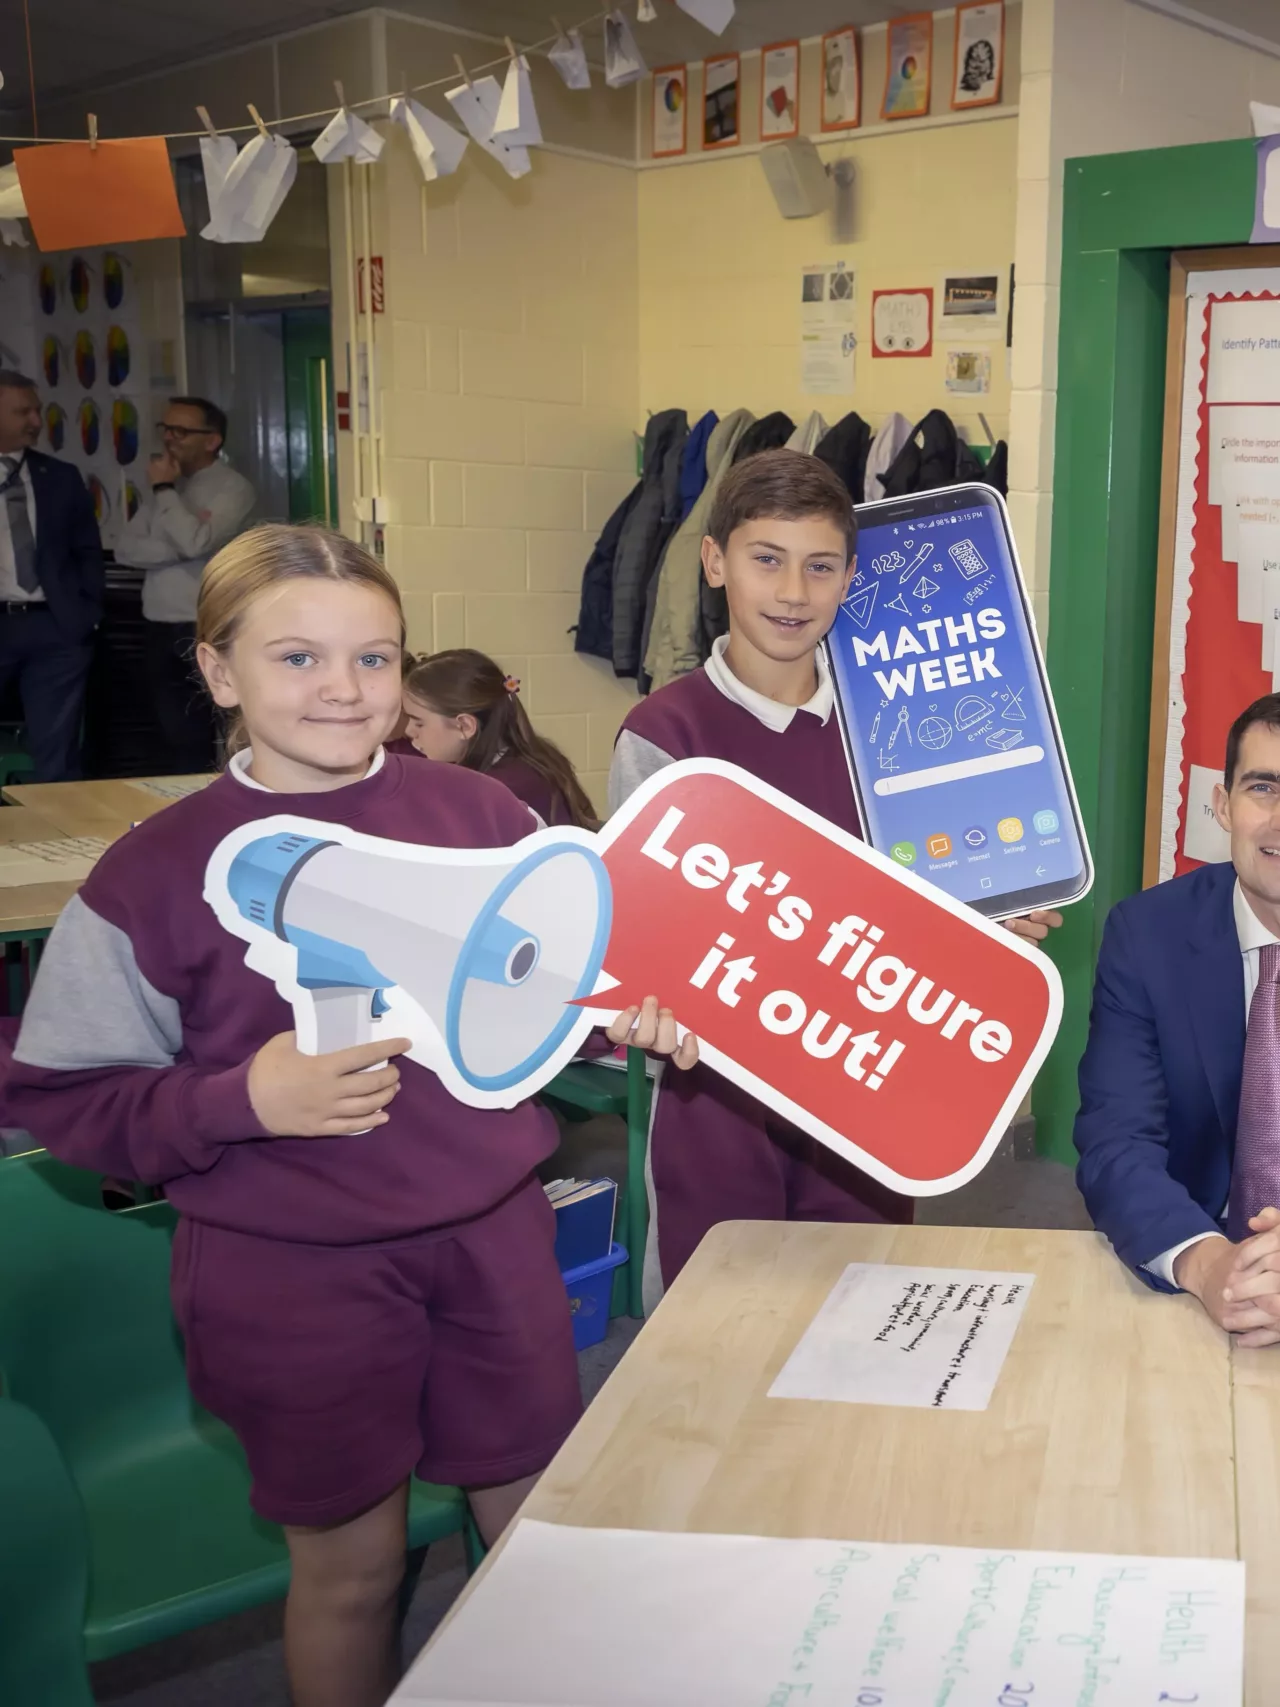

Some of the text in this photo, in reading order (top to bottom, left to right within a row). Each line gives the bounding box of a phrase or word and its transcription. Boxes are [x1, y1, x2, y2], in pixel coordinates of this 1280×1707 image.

[1222, 338, 1256, 351] Identify
[1241, 438, 1254, 447] the
[1234, 454, 1279, 464] information
[1253, 496, 1269, 504] with
[935, 512, 983, 527] 98% 3:15 PM
[1262, 559, 1277, 571] Use
[851, 607, 1006, 668] MATHS
[873, 647, 1002, 701] WEEK
[1039, 836, 1061, 847] Camera
[1003, 844, 1027, 855] Settings
[967, 852, 991, 863] Internet
[928, 858, 958, 872] Messages
[816, 914, 1014, 1064] figure
[688, 932, 906, 1092] it out!
[1158, 1590, 1221, 1665] Health
